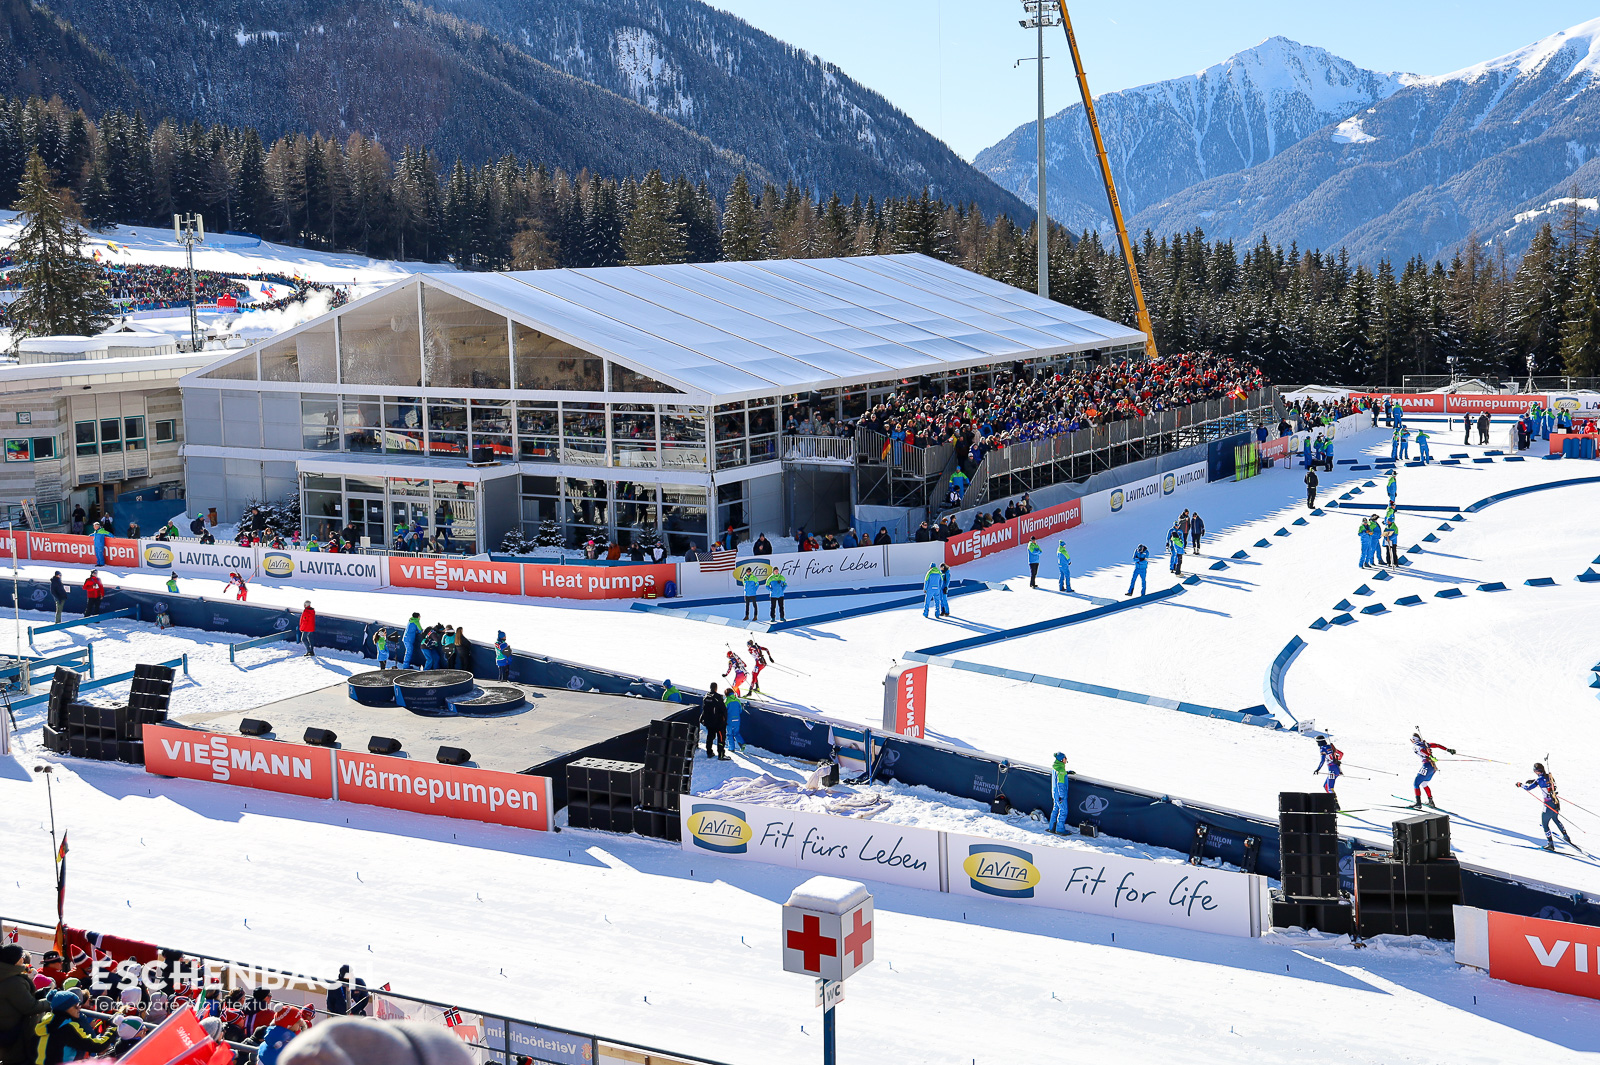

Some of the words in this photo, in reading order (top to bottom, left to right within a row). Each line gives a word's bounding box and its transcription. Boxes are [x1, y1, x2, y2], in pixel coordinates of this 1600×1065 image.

[1585, 401, 1600, 410] LA
[1176, 468, 1205, 486] LAVITA.COM
[1126, 482, 1159, 502] LAVITA.COM
[1021, 507, 1079, 535] Wärmepumpen
[31, 537, 135, 559] Wärmepupen
[951, 530, 1012, 558] VIESSMANN
[179, 551, 252, 569] LAVITA.COM
[299, 560, 377, 578] LAVITA.COM
[780, 559, 800, 576] Fit
[804, 558, 833, 579] fürs
[839, 552, 877, 572] Leben
[400, 560, 507, 589] VIESSMANN
[542, 570, 583, 589] Heat
[588, 574, 655, 593] pumps
[450, 703, 454, 711] 3
[160, 736, 312, 782] VIESSMANN
[338, 758, 539, 812] Wärmepumpen
[760, 821, 793, 851] Fit
[801, 826, 848, 861] fürs
[859, 835, 927, 872] Leben
[1065, 865, 1105, 896] Fit
[1114, 872, 1157, 909] for
[1169, 874, 1220, 917] life
[1525, 934, 1600, 977] VI
[827, 984, 841, 1002] WC
